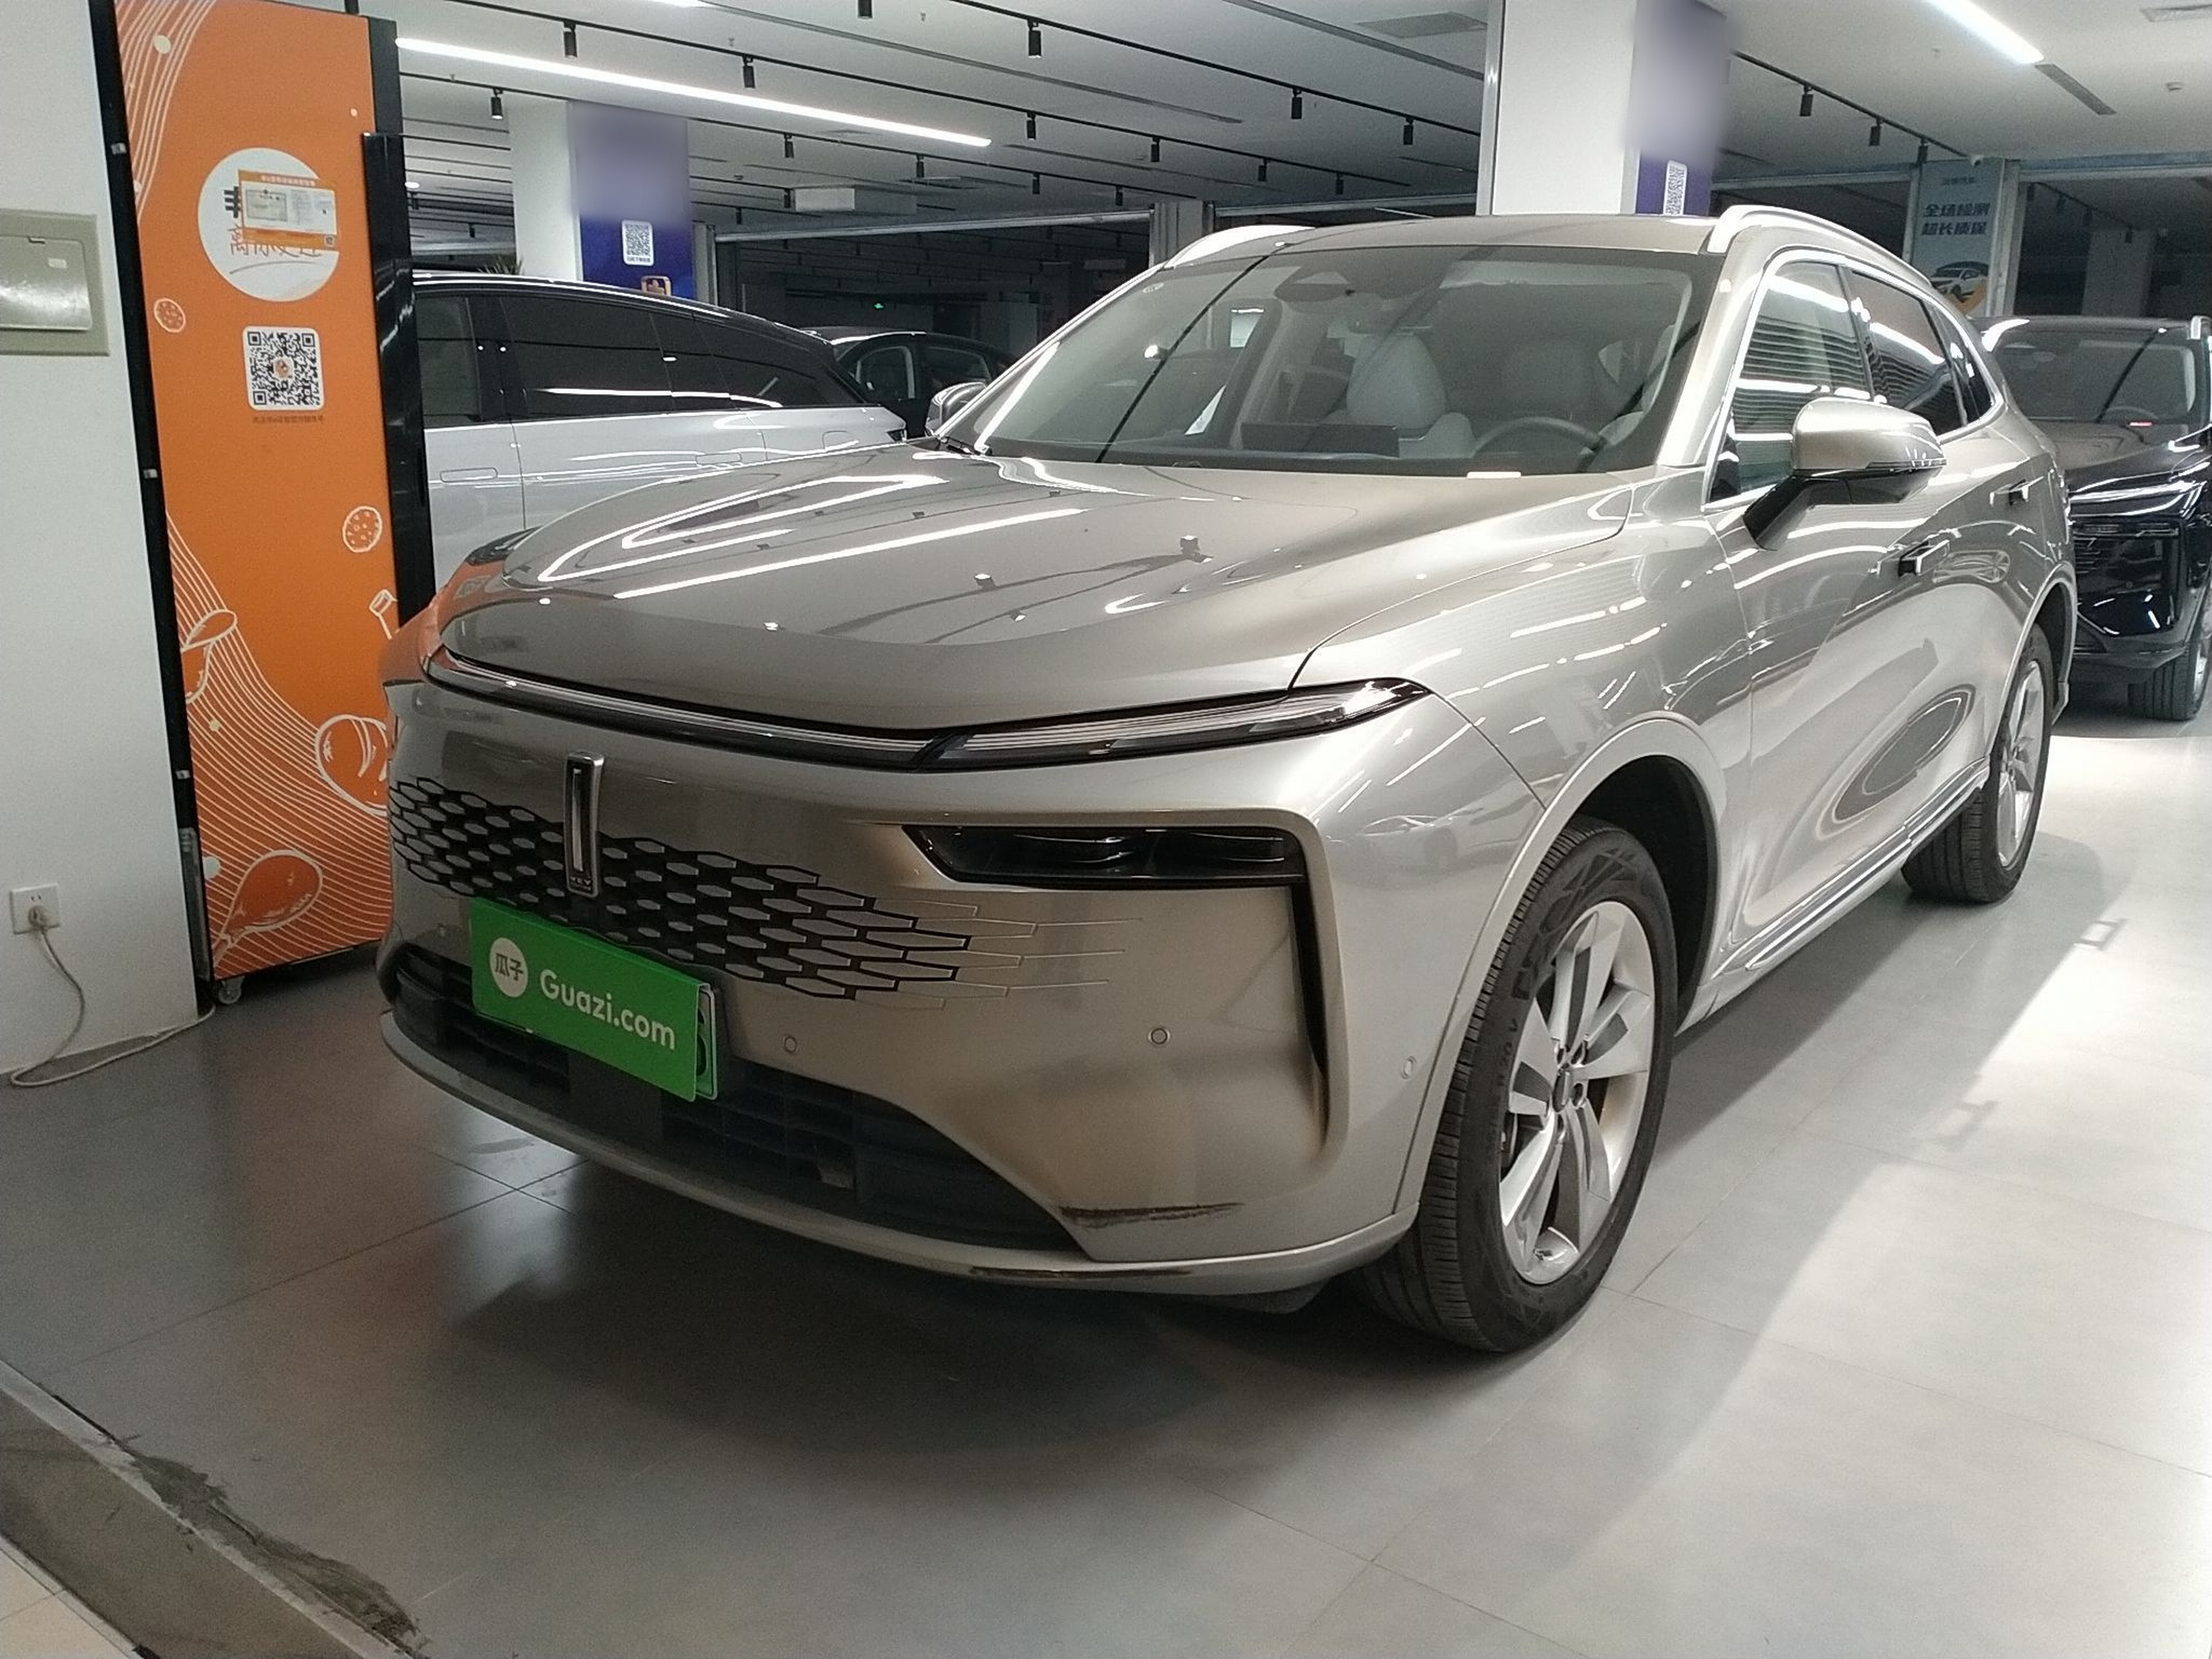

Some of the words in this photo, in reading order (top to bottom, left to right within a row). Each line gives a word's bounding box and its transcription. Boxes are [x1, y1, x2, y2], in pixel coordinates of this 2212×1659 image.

[1921, 222, 1987, 235] 超长质保
[495, 953, 524, 982] 瓜子
[540, 969, 675, 1050] Guazi.com
